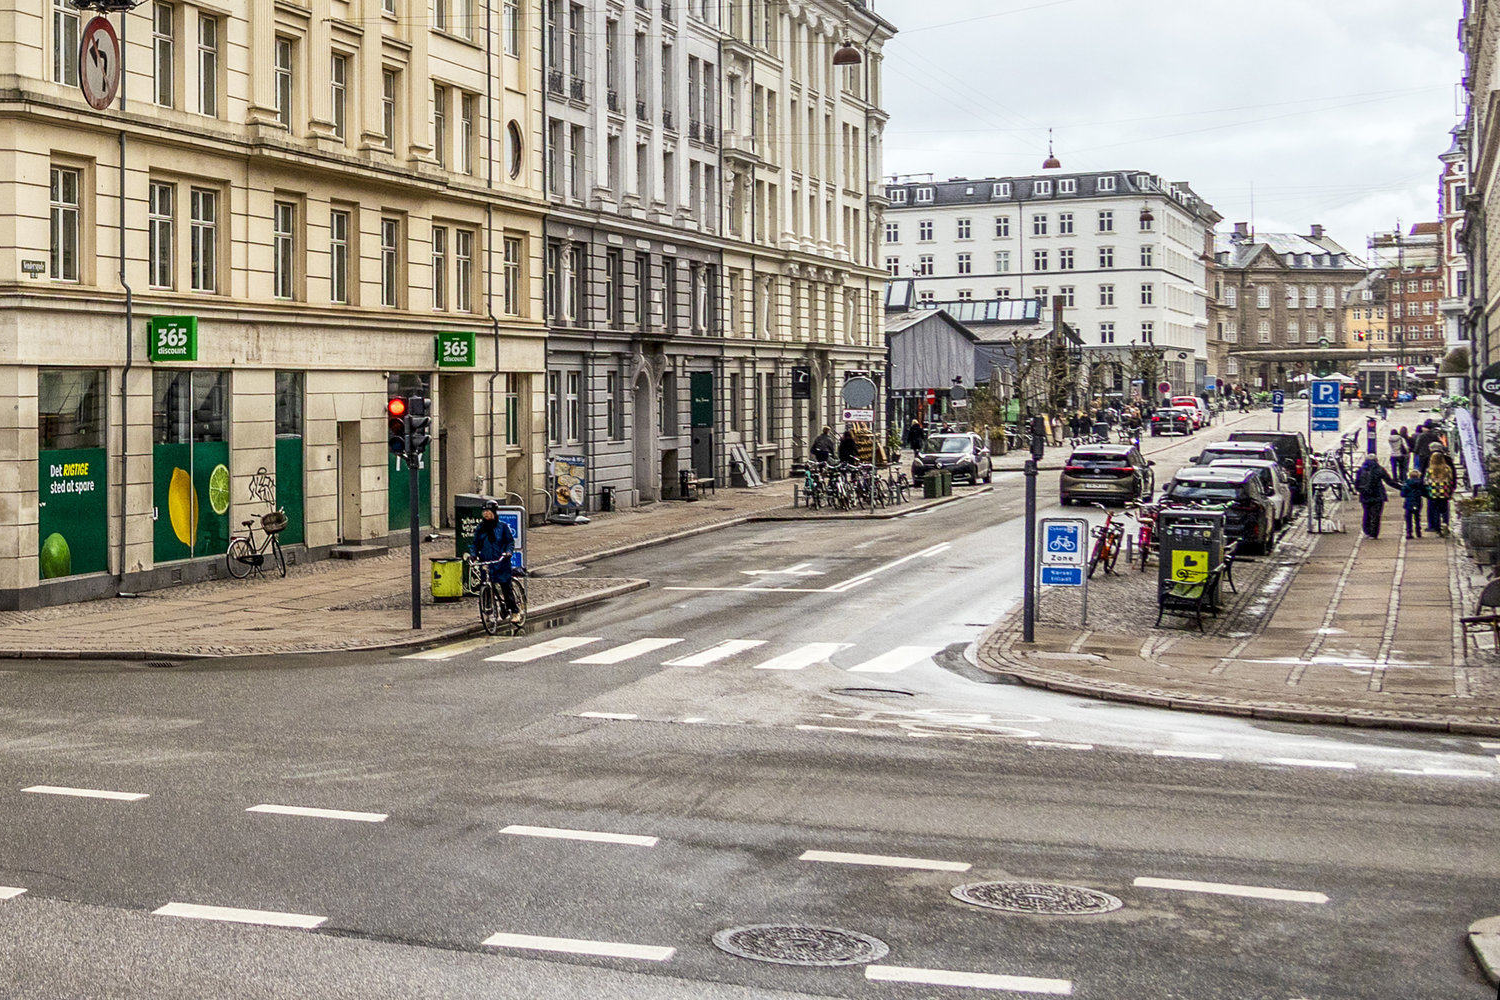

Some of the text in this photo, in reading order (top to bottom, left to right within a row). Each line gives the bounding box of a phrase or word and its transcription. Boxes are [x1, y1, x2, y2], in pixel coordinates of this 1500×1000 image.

[157, 328, 187, 347] 365
[158, 347, 187, 355] discount
[443, 341, 468, 356] 365
[443, 355, 467, 363] discount
[1319, 384, 1333, 400] P
[50, 463, 89, 477] Det RIGTIGE
[50, 480, 94, 494] sted at spare
